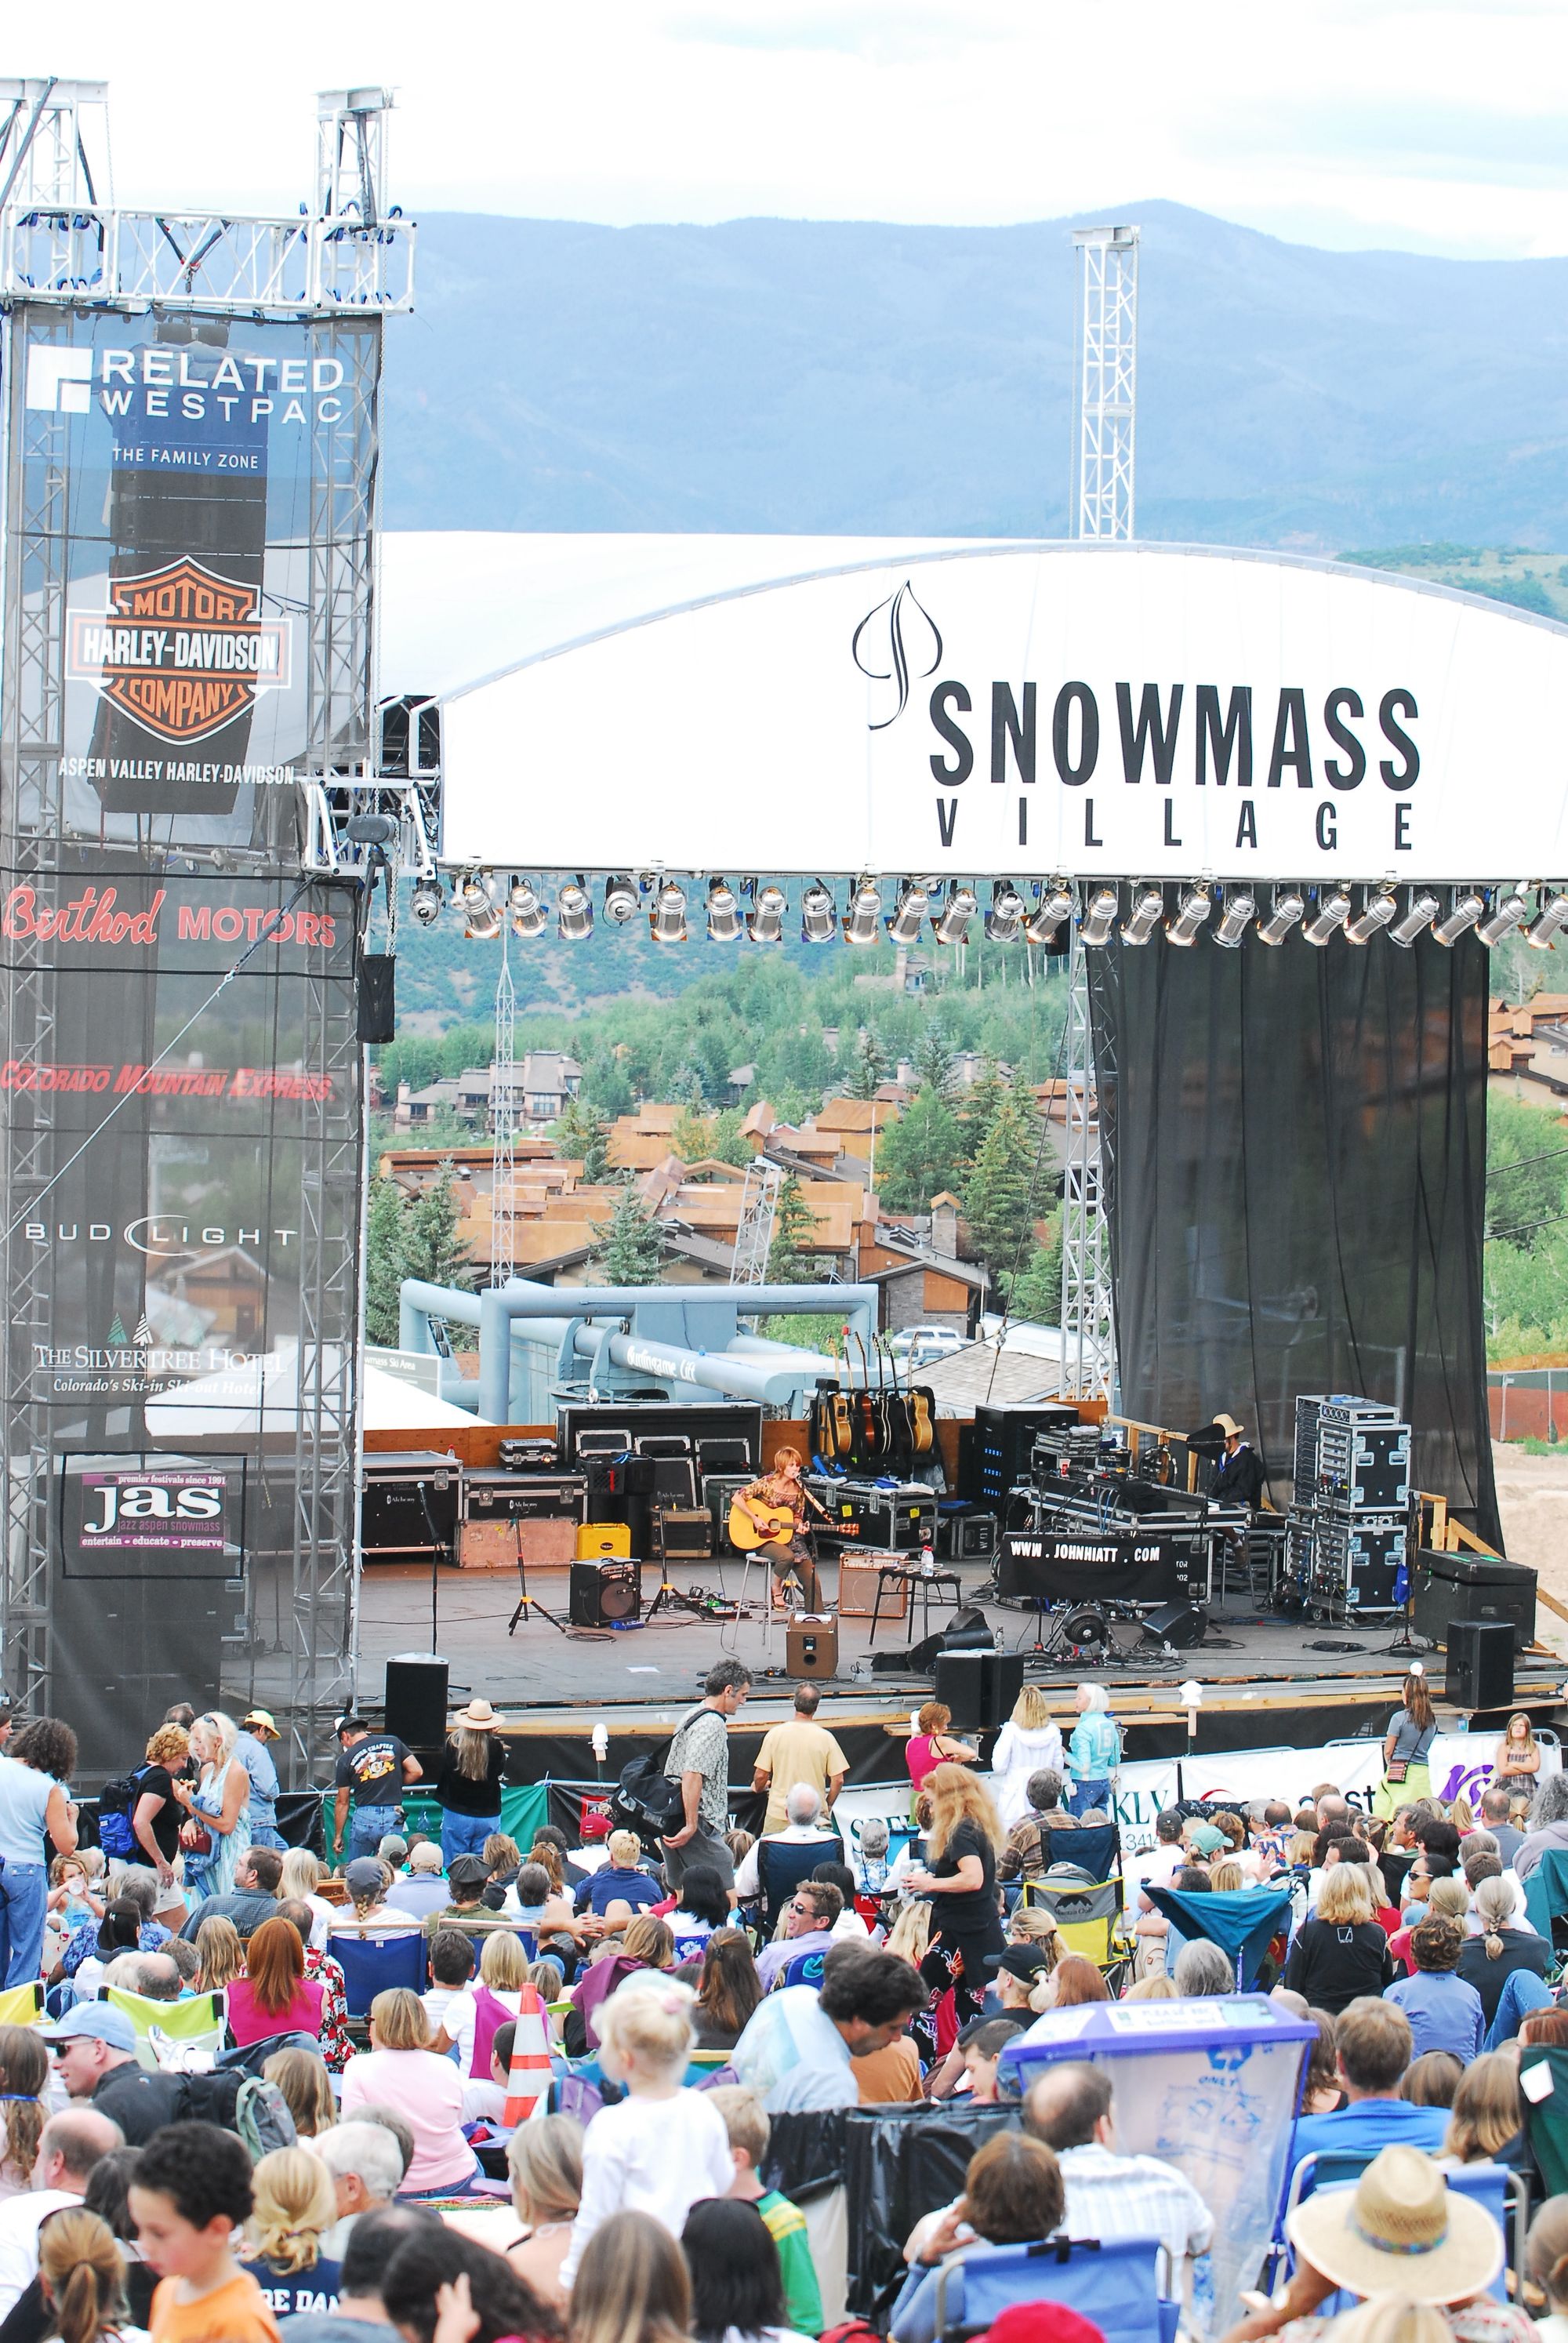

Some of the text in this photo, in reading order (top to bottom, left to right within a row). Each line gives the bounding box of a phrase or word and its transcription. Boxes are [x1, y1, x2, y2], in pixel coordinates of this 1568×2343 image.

[102, 349, 344, 394] RELATED
[104, 390, 343, 425] WESTPAC
[113, 448, 259, 470] THE FAMILY ZONE
[134, 577, 235, 621] MOTOR
[84, 628, 277, 671] HARLEY-DAVIDSON
[129, 679, 234, 727] COMPANY
[929, 680, 1421, 792] SNOWMASS
[59, 757, 106, 778] ASPEN
[110, 758, 163, 780] VALLEY
[937, 797, 1413, 851] VILLAGE
[3, 886, 336, 948] Berthod MOTORS
[26, 1222, 298, 1247] BUD LIGHT
[33, 1343, 288, 1372] THE SILVERTREE HOTEL
[389, 1357, 399, 1368] Ski
[400, 1359, 416, 1371] Area
[53, 1378, 119, 1393] Colorado's
[122, 1379, 164, 1393] Ski-in
[167, 1379, 218, 1394] Ski-out
[118, 1474, 226, 1485] premier festivals since 1991
[84, 1485, 221, 1534] jas
[118, 1519, 220, 1533] jazz aspen snowmass
[82, 1536, 223, 1549] entertain educate preserve
